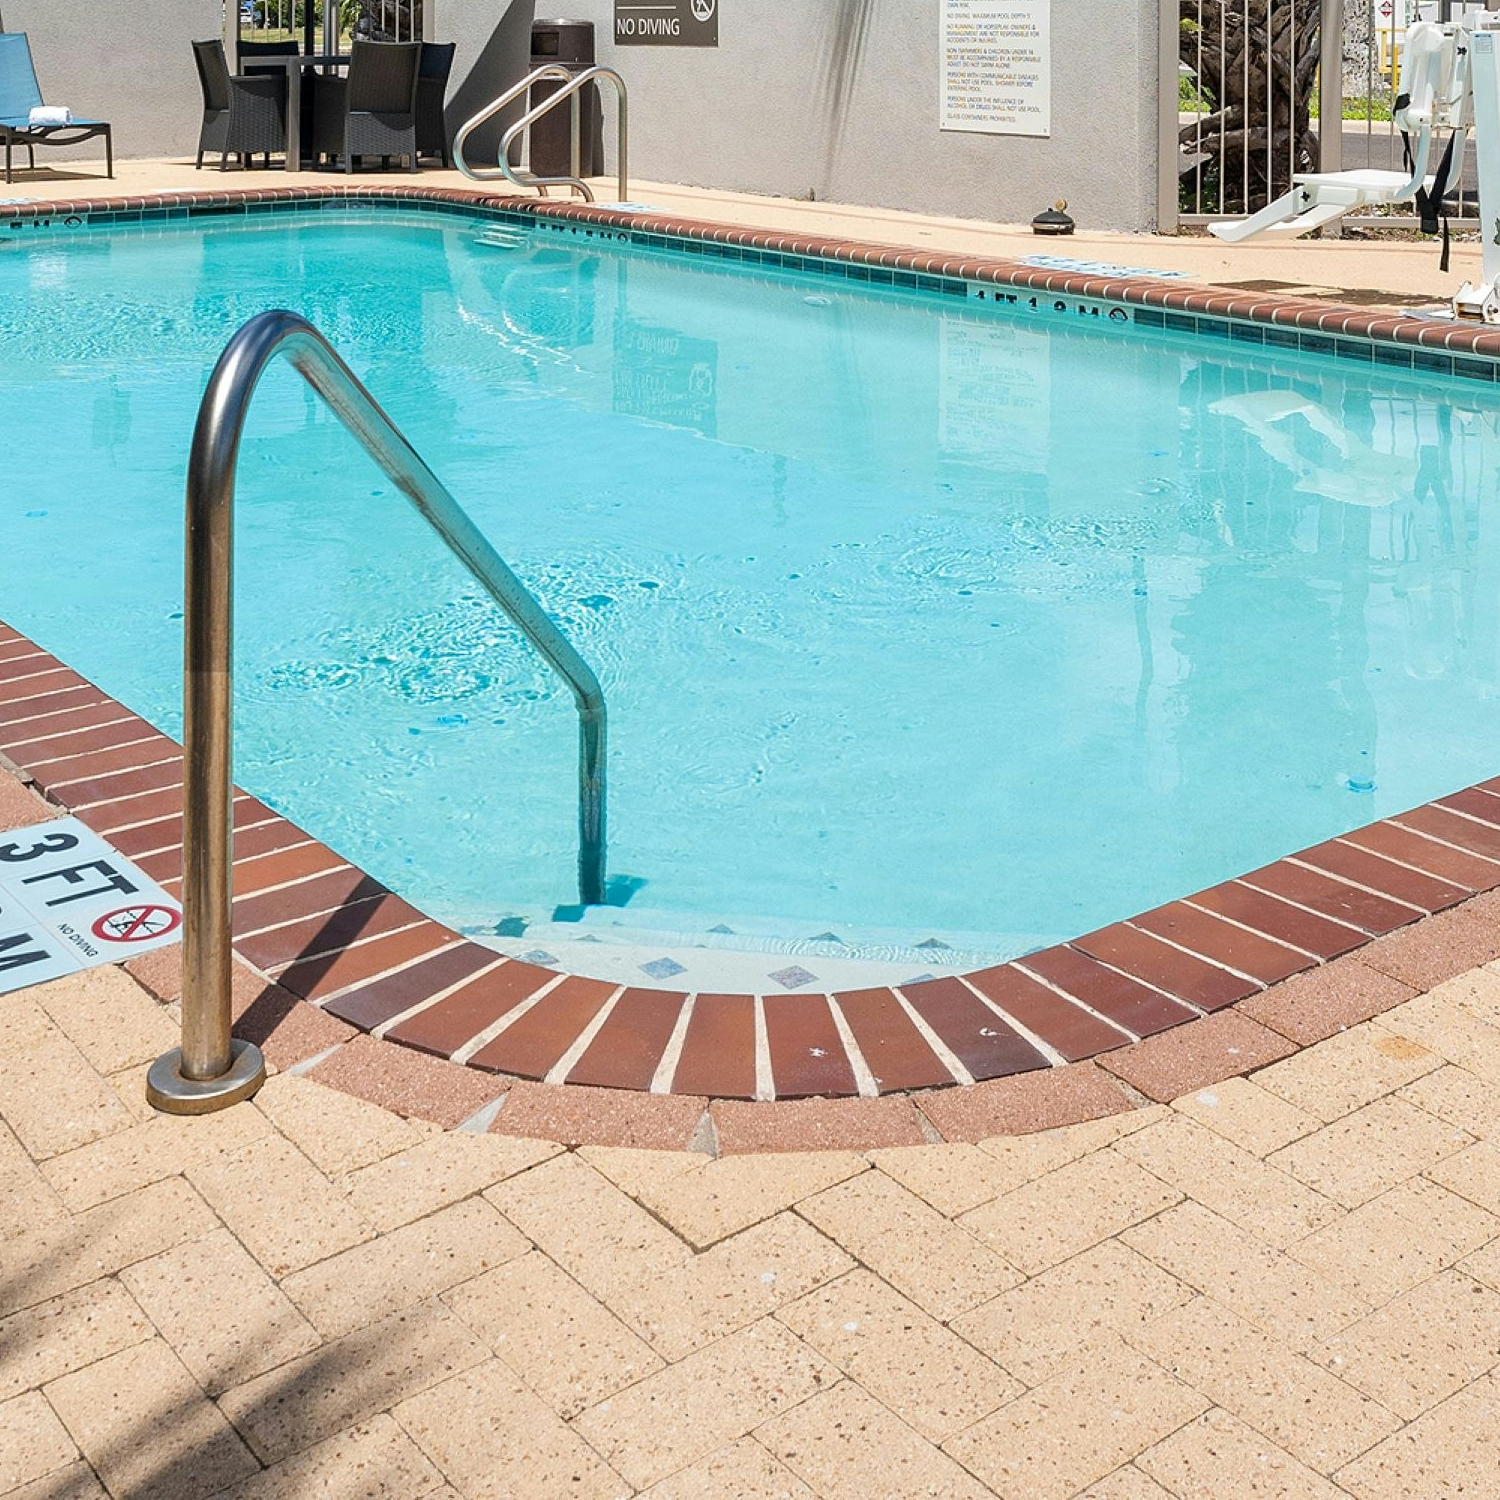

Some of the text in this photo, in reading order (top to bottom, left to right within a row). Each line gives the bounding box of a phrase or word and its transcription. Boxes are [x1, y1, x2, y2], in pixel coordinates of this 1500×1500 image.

[617, 18, 680, 35] NO DIVING
[21, 860, 140, 907] FT
[57, 924, 98, 957] NO DIVING
